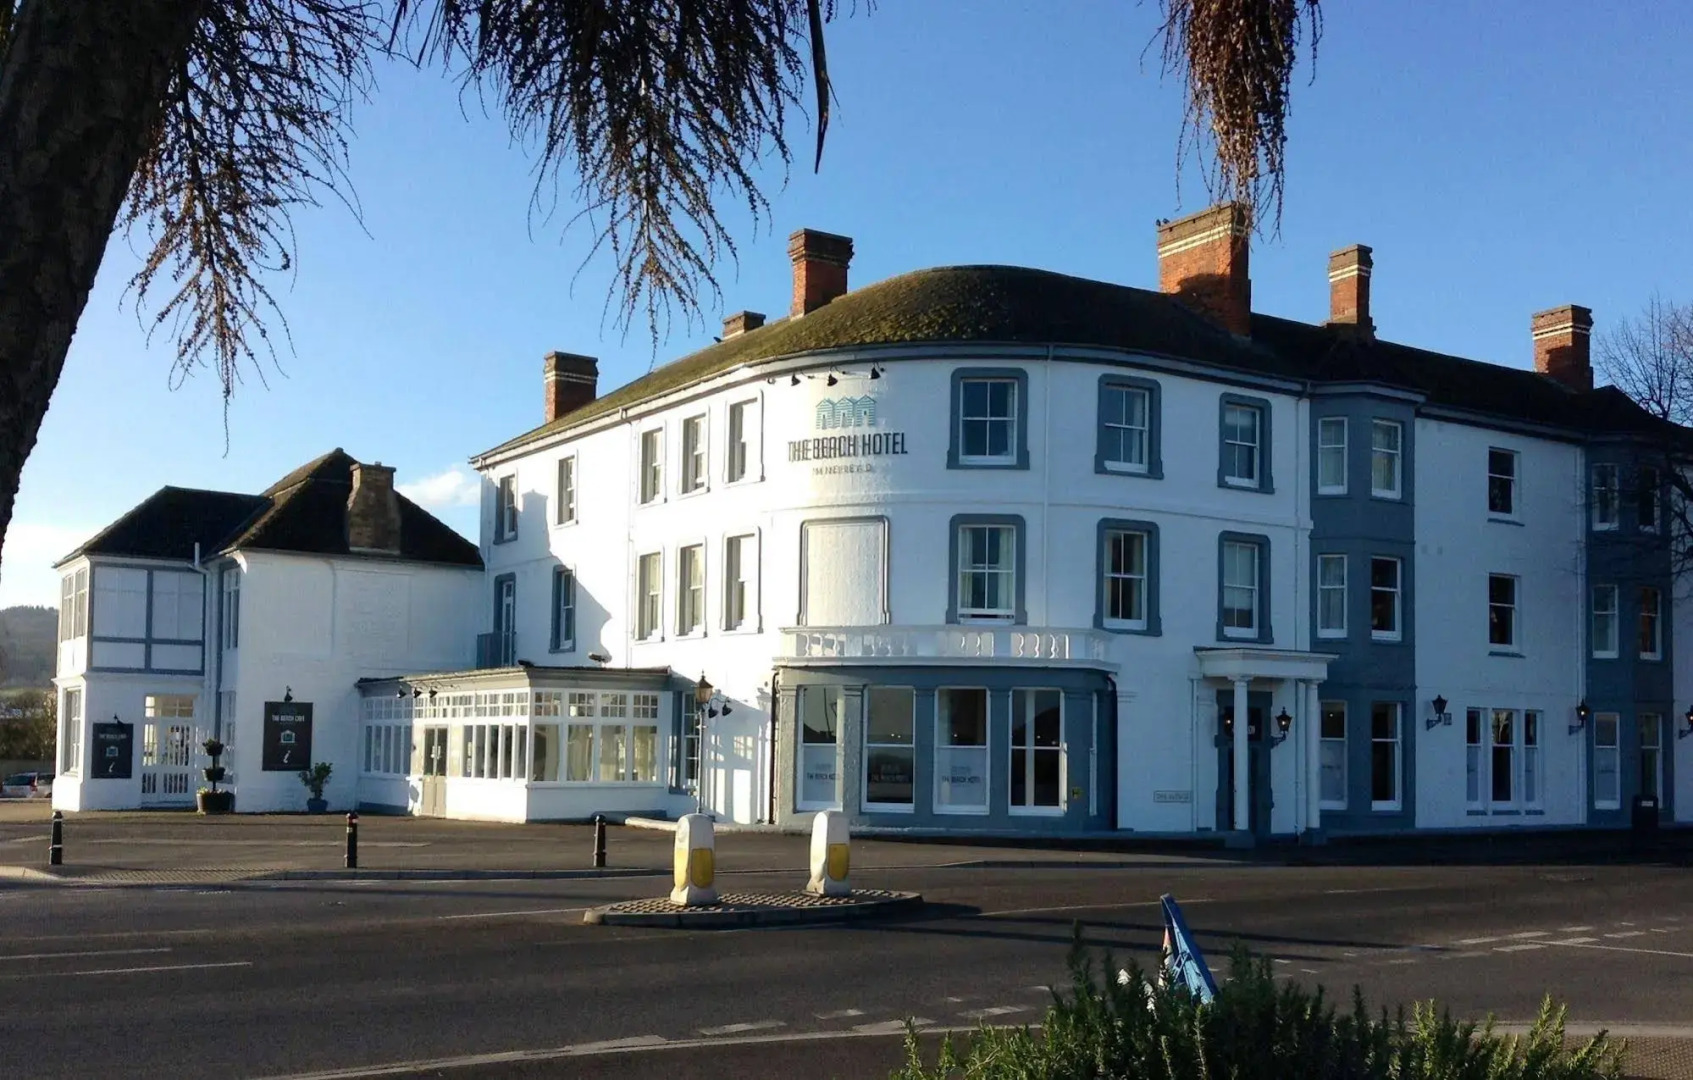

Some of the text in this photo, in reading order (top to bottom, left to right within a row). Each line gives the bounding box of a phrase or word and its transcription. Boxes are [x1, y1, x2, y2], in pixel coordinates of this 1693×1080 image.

[788, 432, 908, 462] THE BEACH HOTEL
